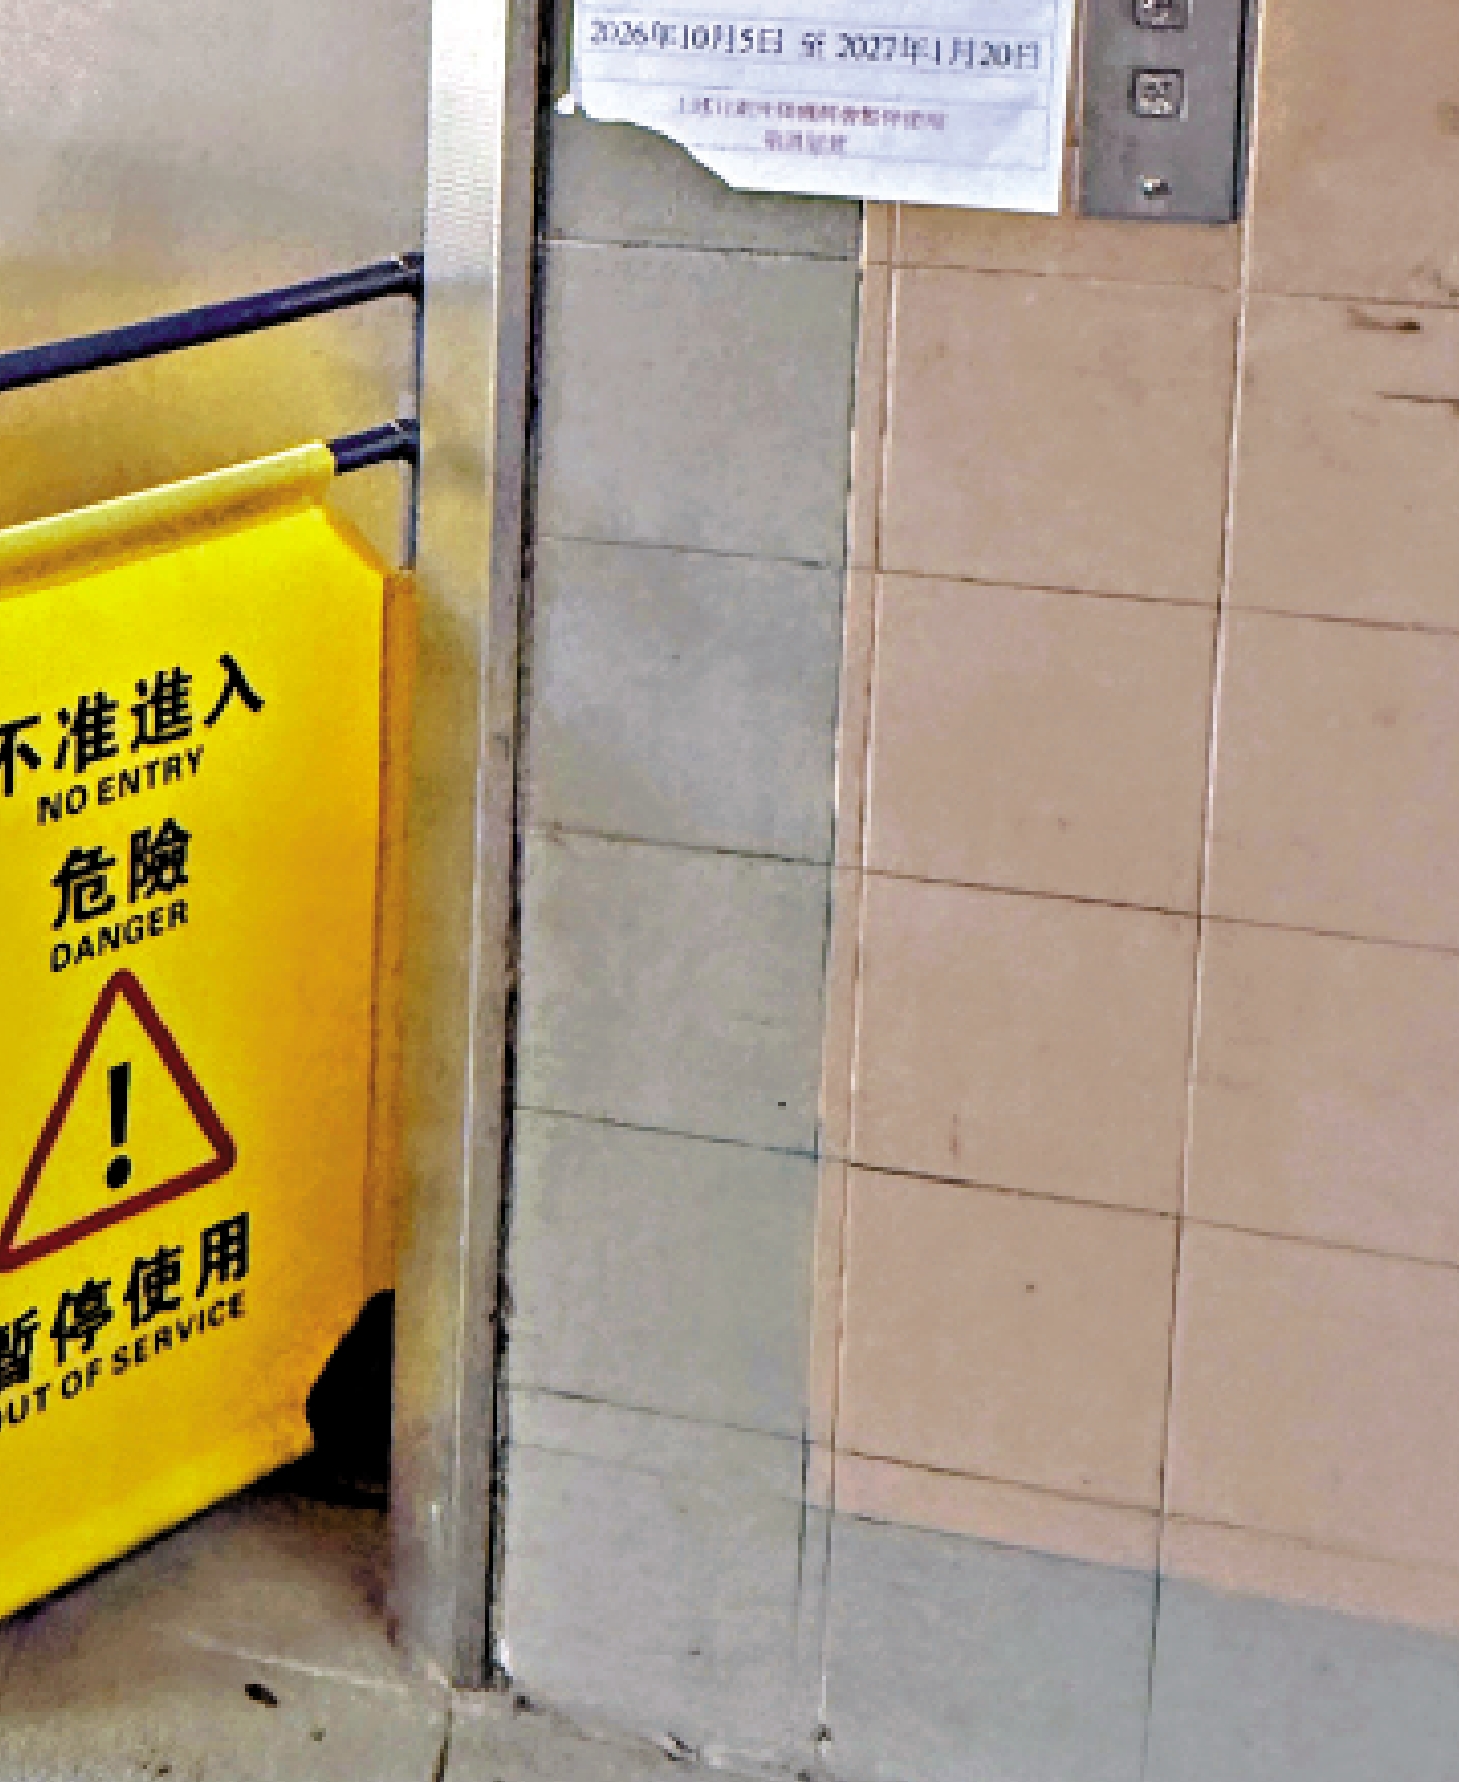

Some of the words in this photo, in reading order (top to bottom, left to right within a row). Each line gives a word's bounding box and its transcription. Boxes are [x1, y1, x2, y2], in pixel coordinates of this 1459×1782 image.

[589, 19, 784, 54] 2026年10月5日
[836, 29, 1041, 71] 2027年1月20日
[37, 784, 87, 825] NO
[97, 744, 203, 805] ENTRY
[50, 818, 191, 929] 危險
[49, 898, 189, 972] DANGER
[61, 1357, 102, 1399] OF
[110, 1288, 246, 1375] SERVICE
